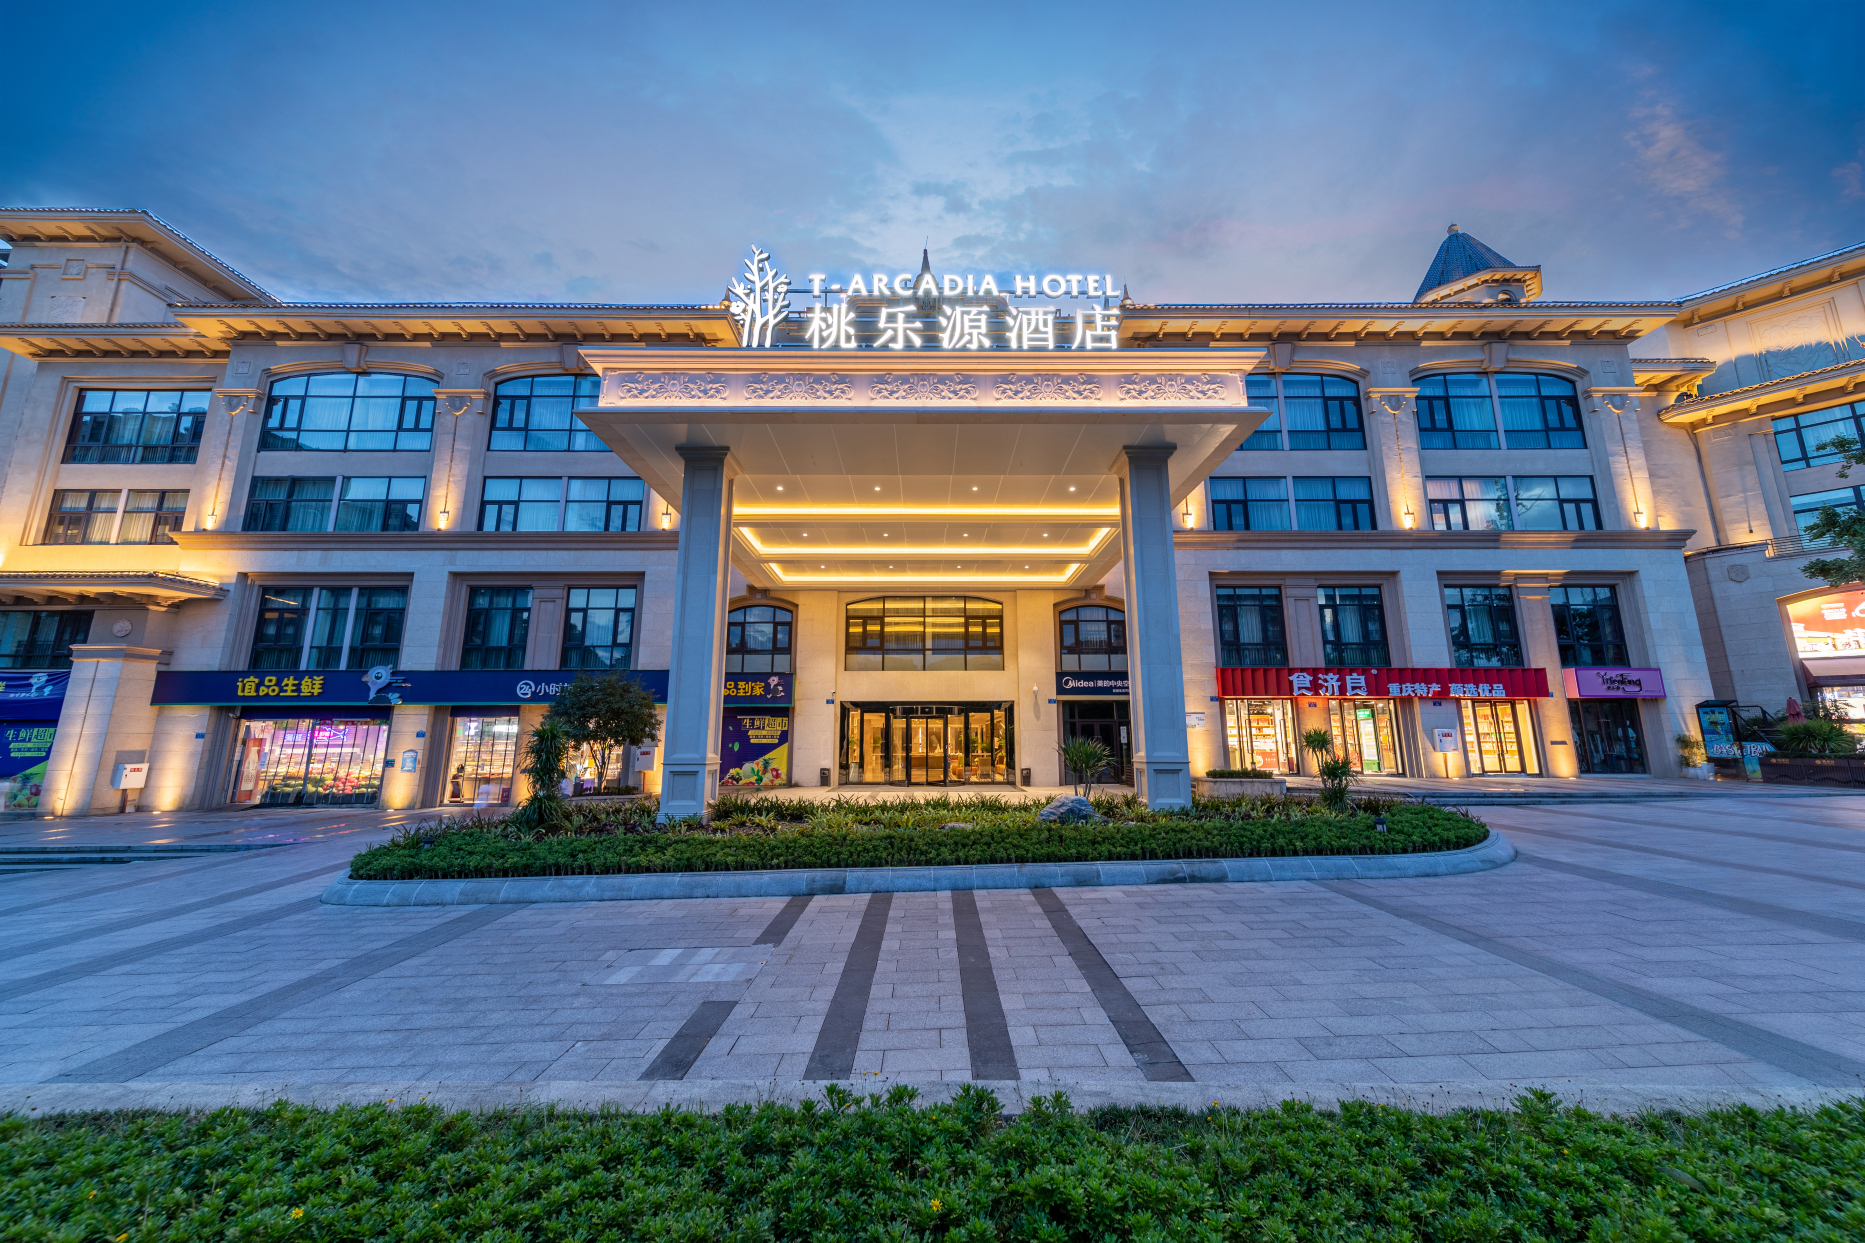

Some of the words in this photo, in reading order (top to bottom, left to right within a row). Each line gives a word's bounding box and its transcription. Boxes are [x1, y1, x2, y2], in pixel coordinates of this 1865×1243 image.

[808, 273, 999, 298] T-ARCADIA
[1014, 274, 1121, 298] HOTEL
[804, 303, 1121, 350] 桃乐源酒店
[236, 675, 325, 697] 谊品生鲜
[723, 681, 765, 696] 品到家
[1062, 676, 1094, 689] Midea
[1288, 672, 1368, 697] 食济良
[1387, 683, 1441, 697] 重庆特产
[742, 717, 788, 730] 生鲜超市
